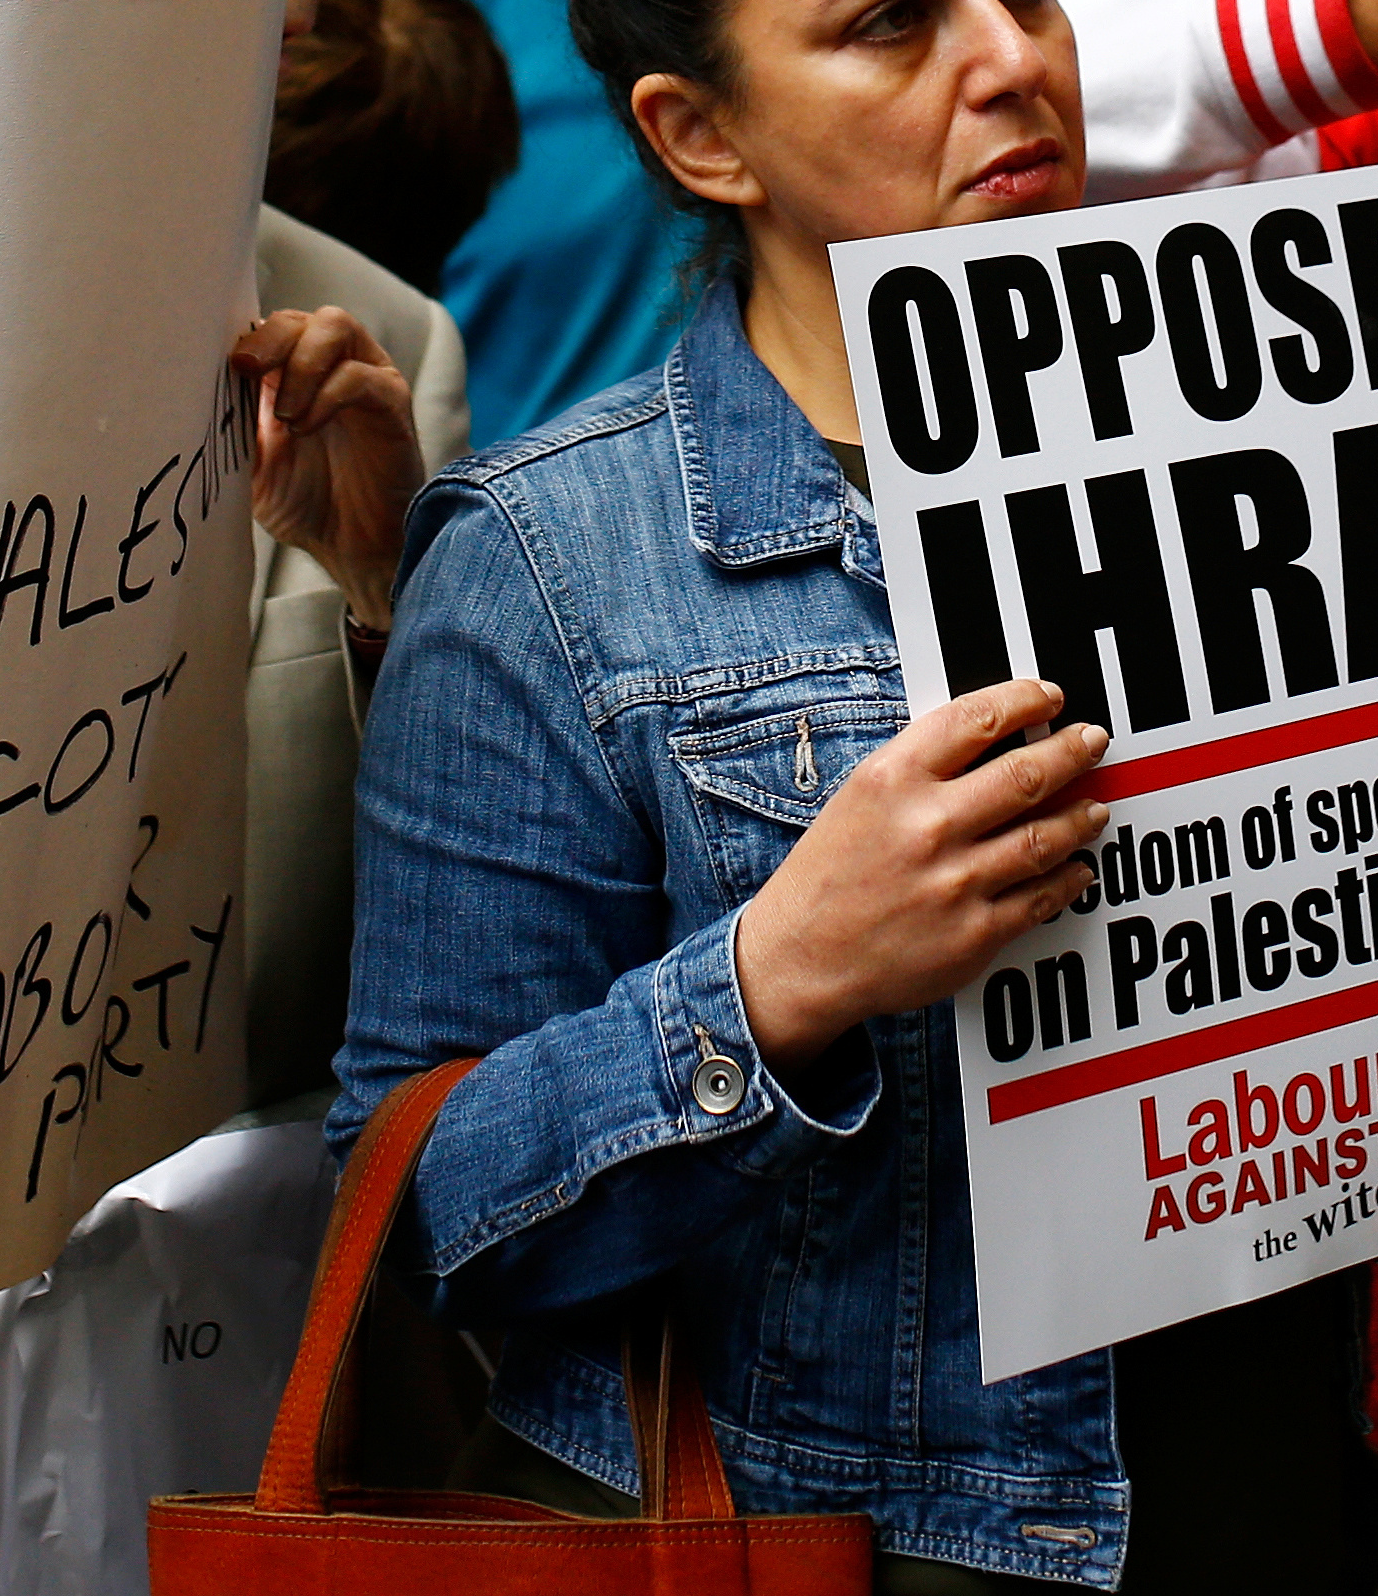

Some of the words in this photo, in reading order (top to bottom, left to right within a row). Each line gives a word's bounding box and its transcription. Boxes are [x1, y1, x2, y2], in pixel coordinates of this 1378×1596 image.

[1040, 820, 1233, 926] edom
[1240, 784, 1298, 871] of
[981, 945, 1093, 1065] on
[1252, 1228, 1298, 1263] the
[161, 1320, 222, 1365] NO
